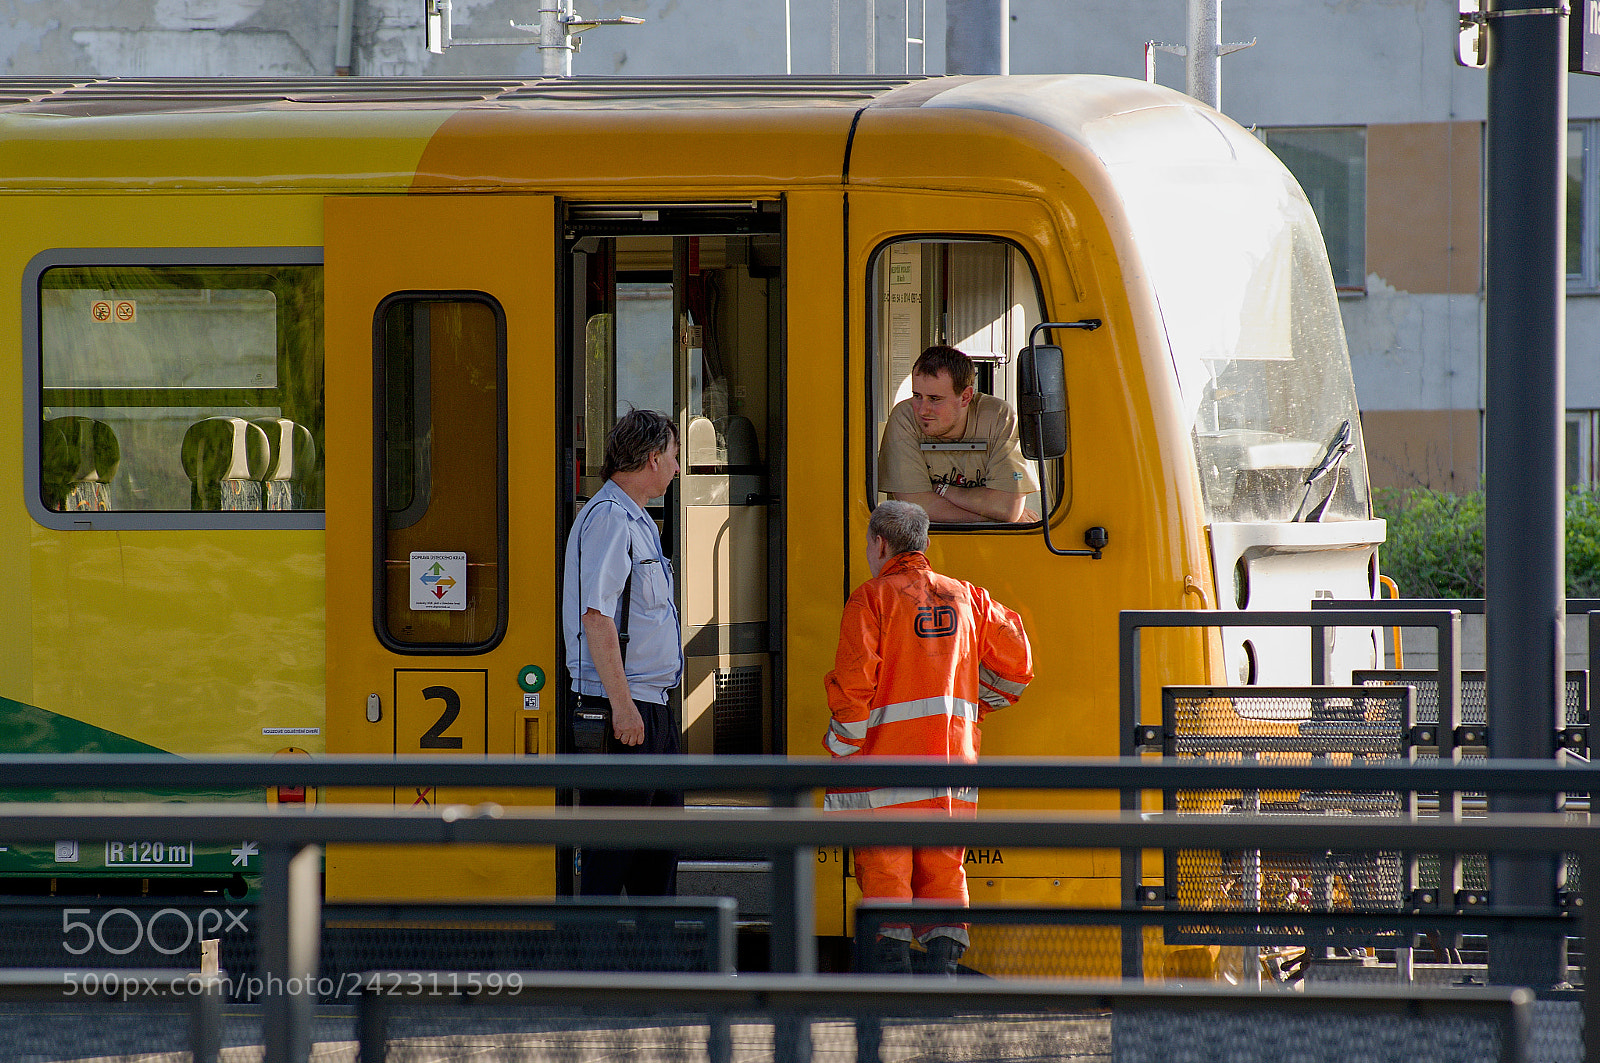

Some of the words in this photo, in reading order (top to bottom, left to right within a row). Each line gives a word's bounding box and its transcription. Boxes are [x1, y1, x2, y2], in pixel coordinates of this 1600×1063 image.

[420, 685, 463, 749] 2
[110, 841, 124, 862] R
[128, 841, 164, 862] 120
[168, 846, 186, 862] m
[964, 849, 1004, 864] AHA
